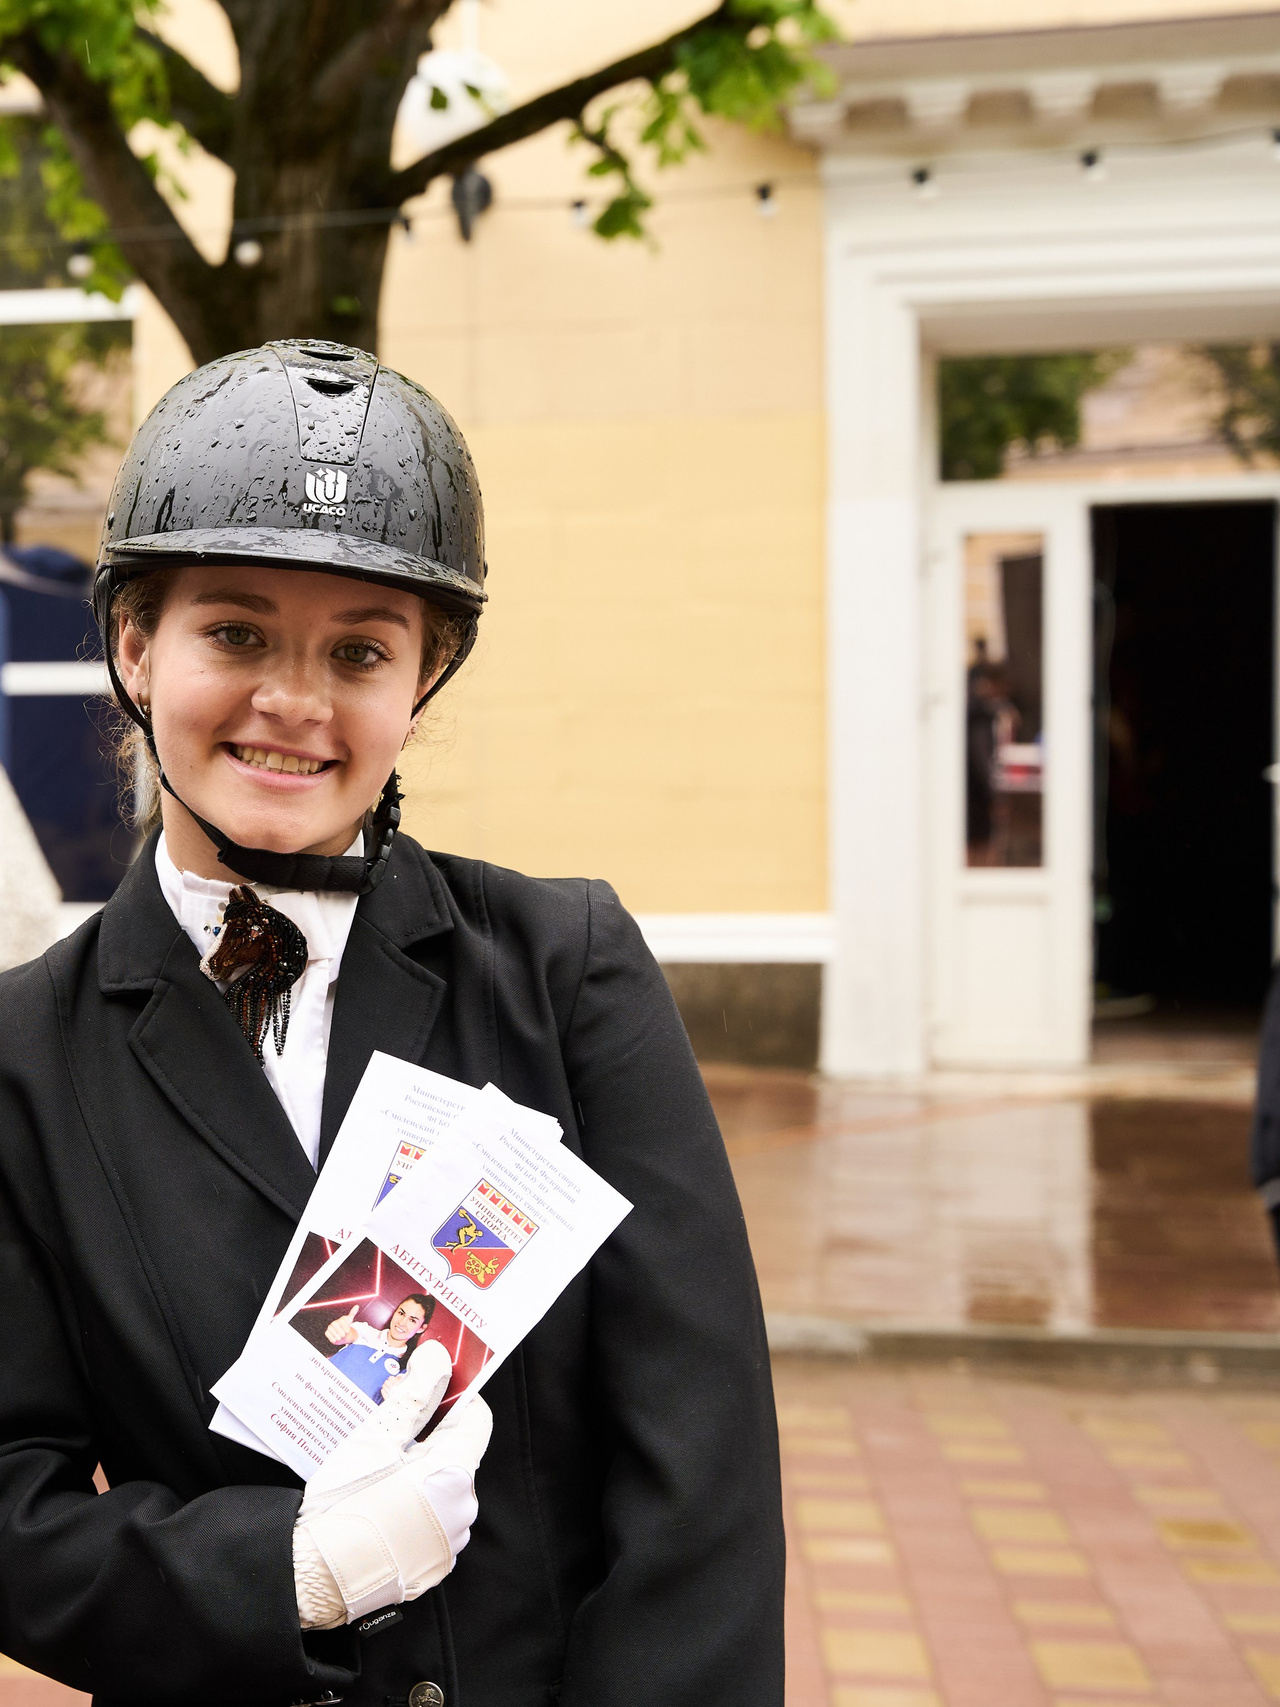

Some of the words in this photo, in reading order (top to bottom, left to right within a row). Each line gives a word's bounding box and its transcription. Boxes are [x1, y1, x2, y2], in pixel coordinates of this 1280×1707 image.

[303, 503, 346, 516] UCACO
[470, 1196, 524, 1244] УНИВЕРСИТЕТ
[475, 1211, 508, 1241] СПОРТА
[390, 1244, 487, 1329] АБИТУРИЕНТУ
[270, 1413, 296, 1441] София
